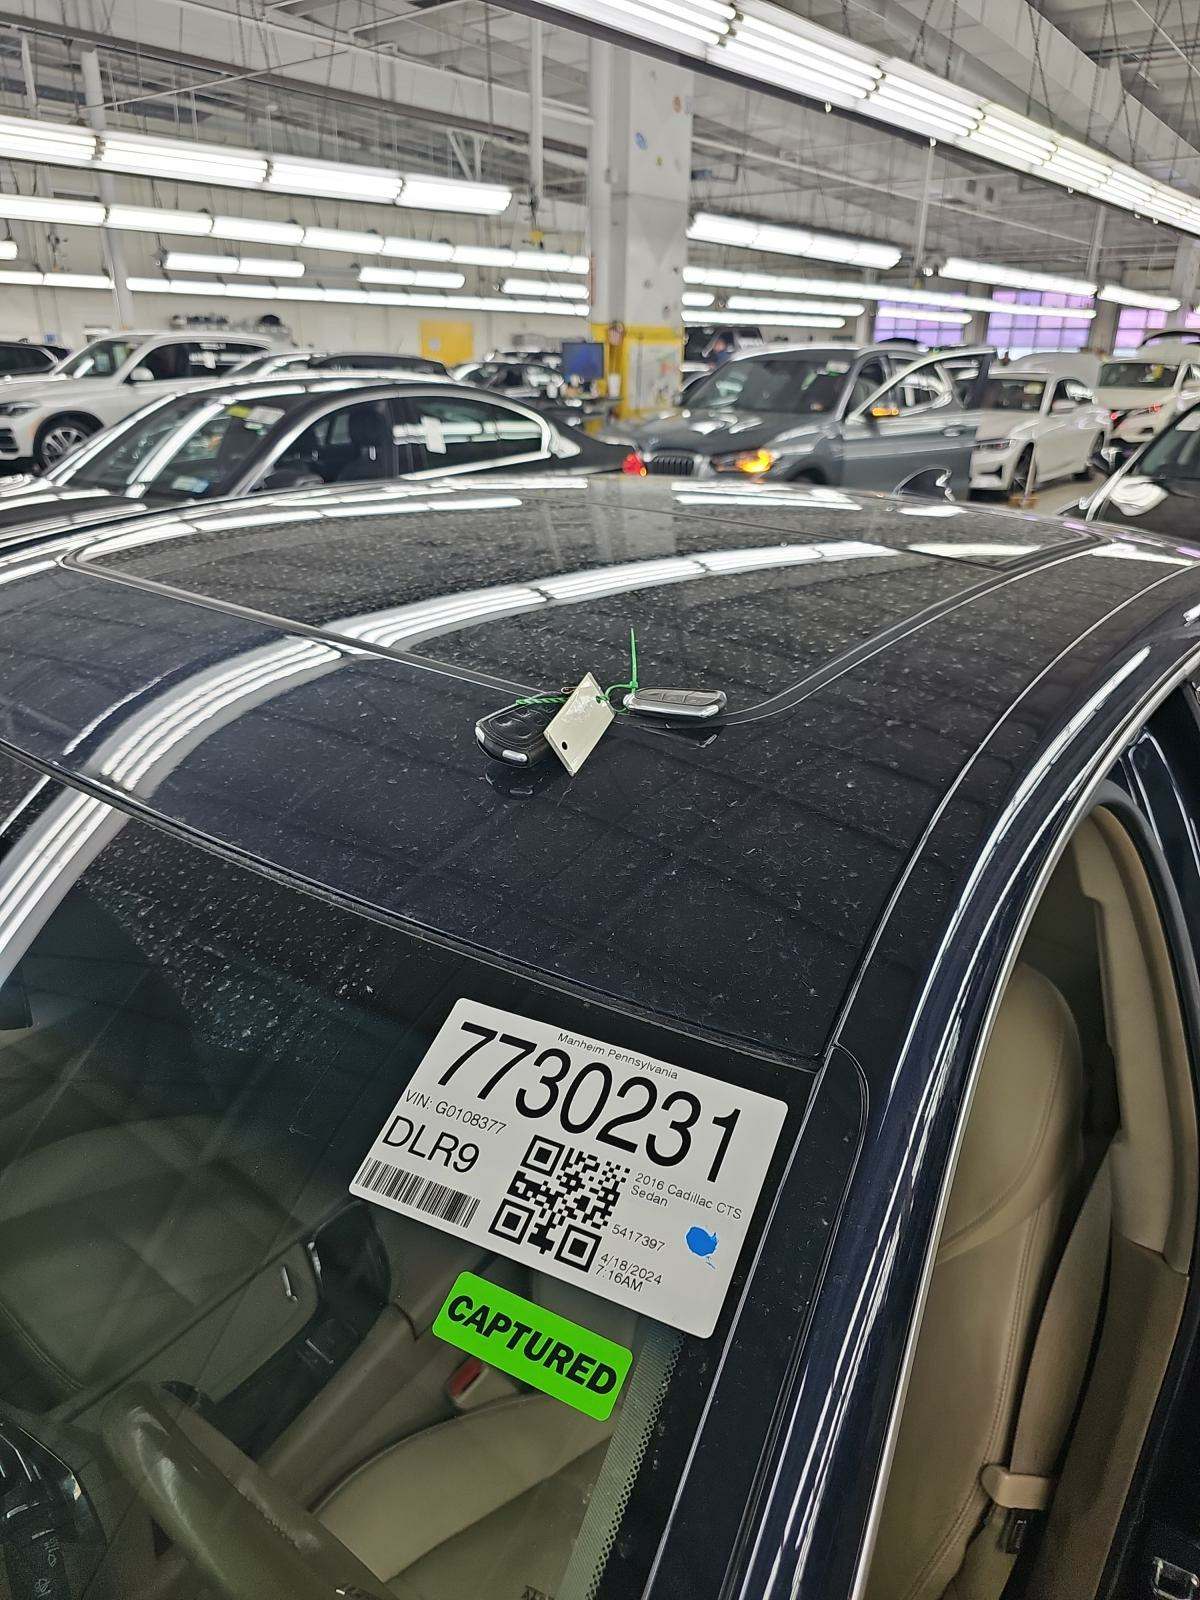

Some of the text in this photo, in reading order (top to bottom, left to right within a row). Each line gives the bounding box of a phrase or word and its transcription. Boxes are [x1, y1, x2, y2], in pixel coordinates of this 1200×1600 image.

[557, 1032, 679, 1080] Manheim Pennsylvania
[405, 1089, 507, 1135] VIN: G0108377
[437, 1021, 741, 1183] 7730231
[382, 1115, 480, 1173] DLR9
[630, 1184, 668, 1207] Sedan
[634, 1172, 743, 1220] 2016 Cadillac CTS
[611, 1223, 666, 1252] 5417397
[595, 1264, 644, 1292] 7:16AM
[600, 1253, 663, 1285] 4/18/2024
[447, 1295, 617, 1395] CAPTURED
